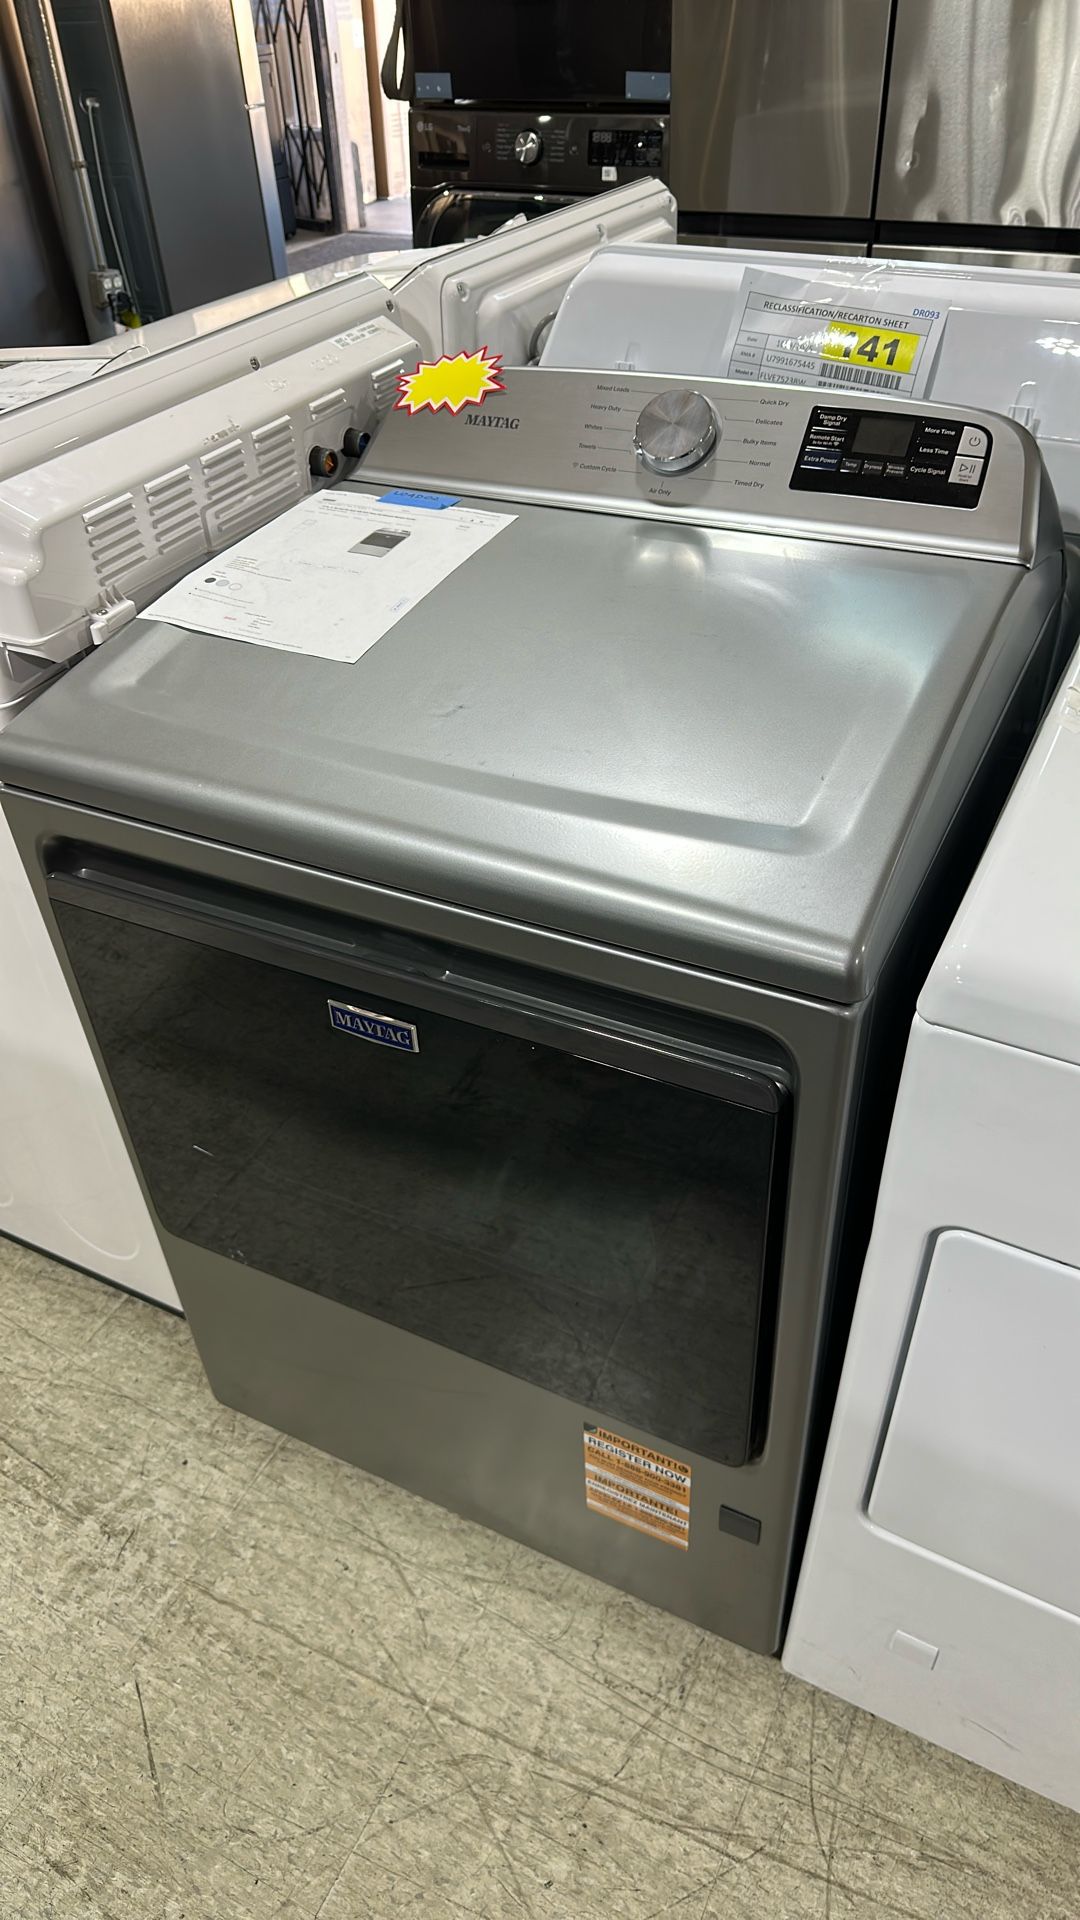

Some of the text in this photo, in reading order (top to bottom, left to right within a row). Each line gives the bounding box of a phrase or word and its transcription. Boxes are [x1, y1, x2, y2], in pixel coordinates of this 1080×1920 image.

[763, 301, 910, 329] RECLASSIFICATION/RECARTON SHEET
[912, 308, 940, 320] DR093
[842, 331, 900, 366] 141
[766, 354, 815, 370] U7991675445
[590, 403, 608, 411] Heavy
[464, 414, 520, 429] MAYTAG
[755, 418, 783, 426] Delicates
[819, 413, 836, 421] Damp
[809, 433, 830, 441] Remote
[941, 428, 956, 436] Time
[578, 442, 597, 450] Towels
[743, 438, 759, 446] Bulky
[579, 463, 617, 473] Custom Cycle
[734, 479, 765, 489] Timed Dry
[658, 488, 672, 496] Only
[335, 1011, 410, 1046] MAYTAG
[587, 1446, 611, 1460] CALL
[598, 1430, 678, 1470] IMPORTANT!
[588, 1436, 651, 1469] REGISTER
[655, 1465, 687, 1483] NOW
